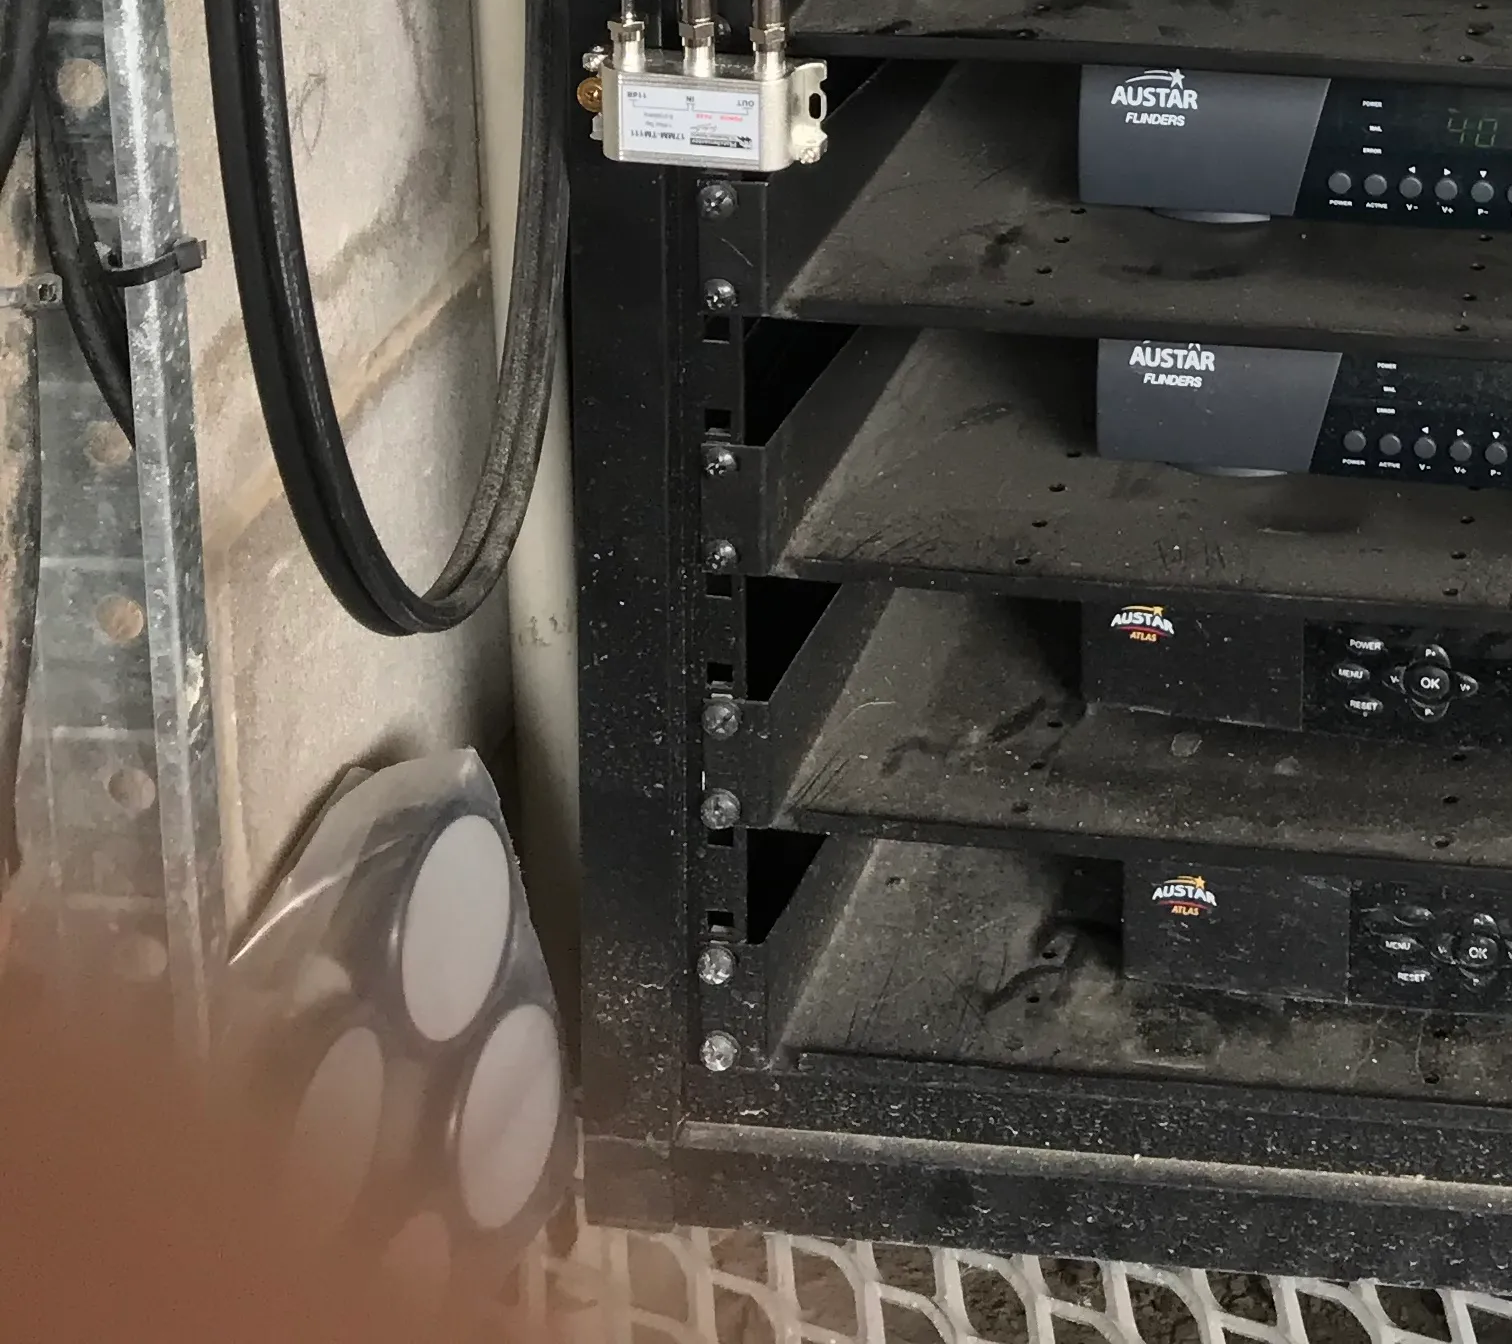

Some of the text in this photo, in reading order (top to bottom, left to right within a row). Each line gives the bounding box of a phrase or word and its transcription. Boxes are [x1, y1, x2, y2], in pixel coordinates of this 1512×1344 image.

[686, 95, 695, 103] IN
[1111, 85, 1198, 110] AUSTAR
[737, 100, 755, 109] OUT
[1125, 112, 1186, 127] FLINDERS
[1129, 346, 1215, 372] AUSTAR
[1143, 372, 1203, 388] FLINDERS
[1111, 611, 1175, 636] AUSTAR
[1130, 631, 1157, 643] ATLAS
[1349, 639, 1382, 650] POWER
[1338, 668, 1363, 679] MENU
[1420, 677, 1440, 690] OK
[1349, 700, 1378, 711] RESET
[1152, 884, 1217, 907] AUSTAR
[1171, 905, 1199, 916] ATLAS
[1469, 946, 1488, 959] OK
